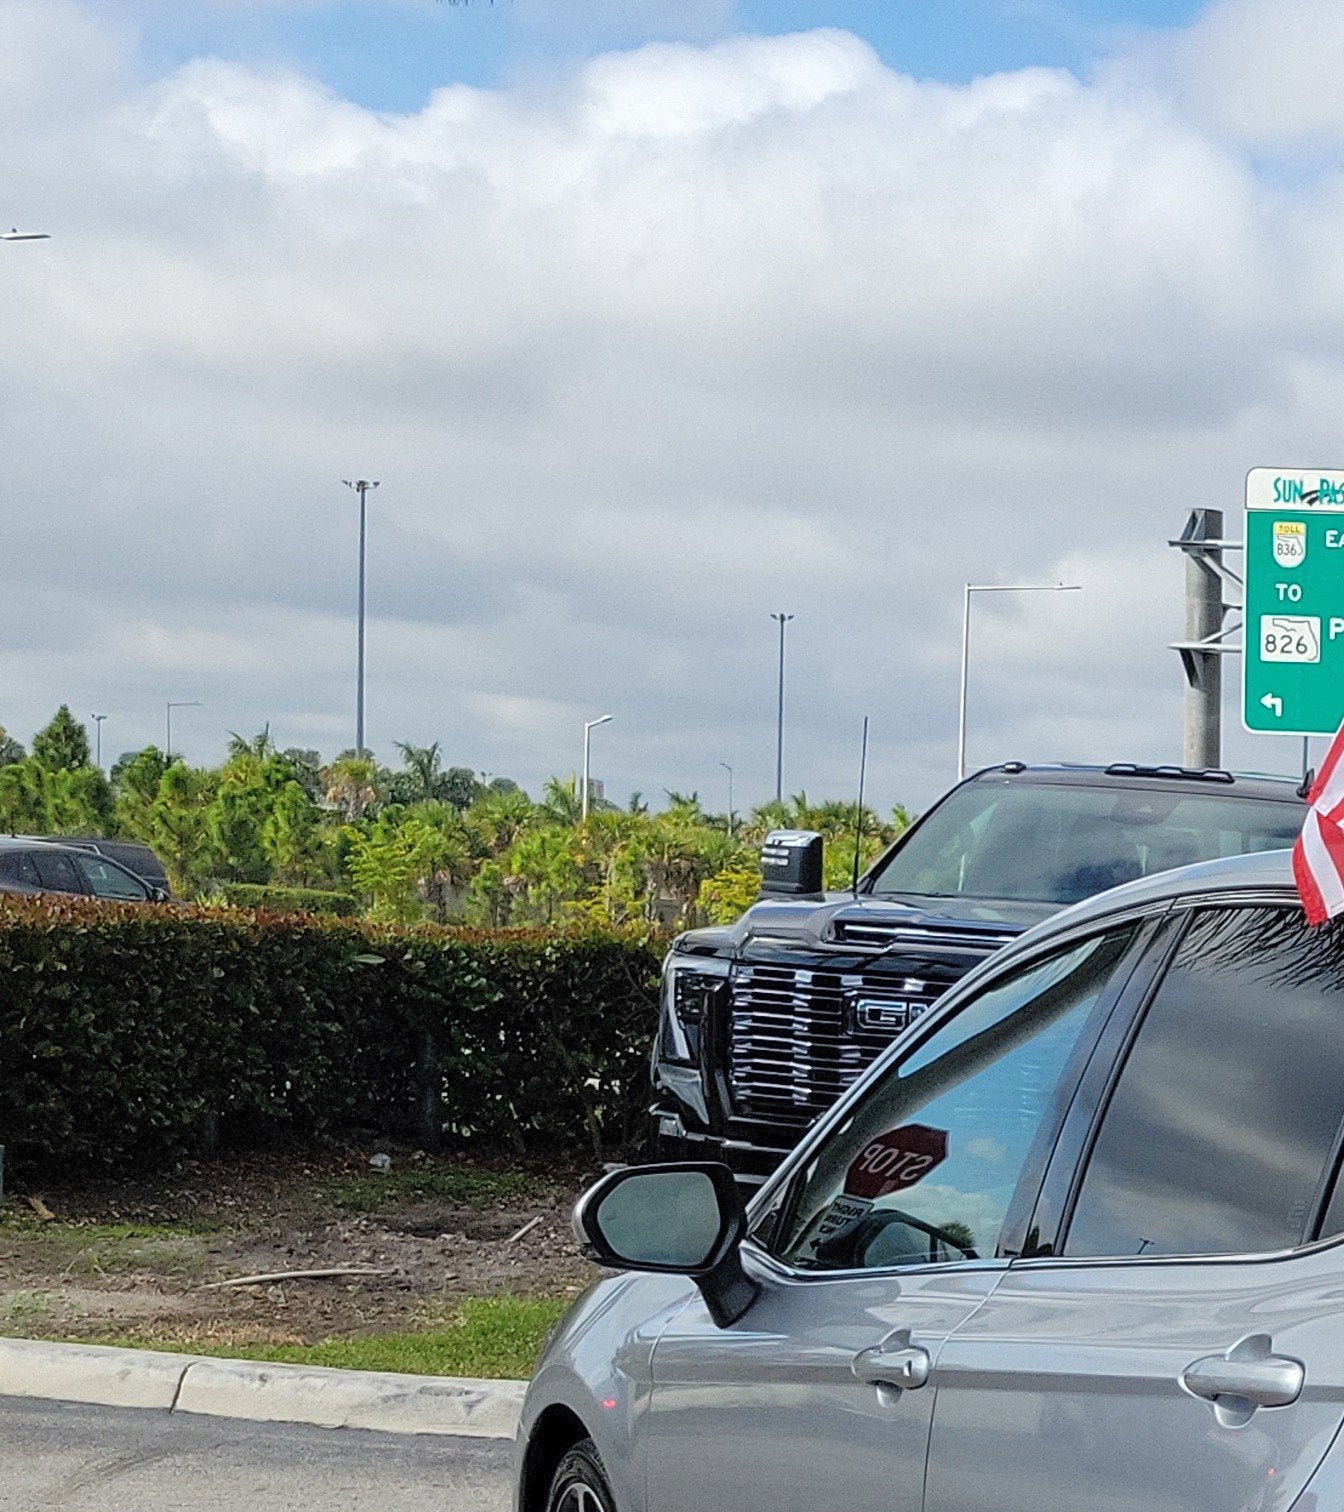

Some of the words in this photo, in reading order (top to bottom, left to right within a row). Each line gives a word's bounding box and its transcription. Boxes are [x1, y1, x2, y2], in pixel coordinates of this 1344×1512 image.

[1278, 525, 1301, 534] TOLL
[1276, 543, 1298, 556] 836
[1275, 582, 1303, 602] TO
[1264, 634, 1309, 655] 826
